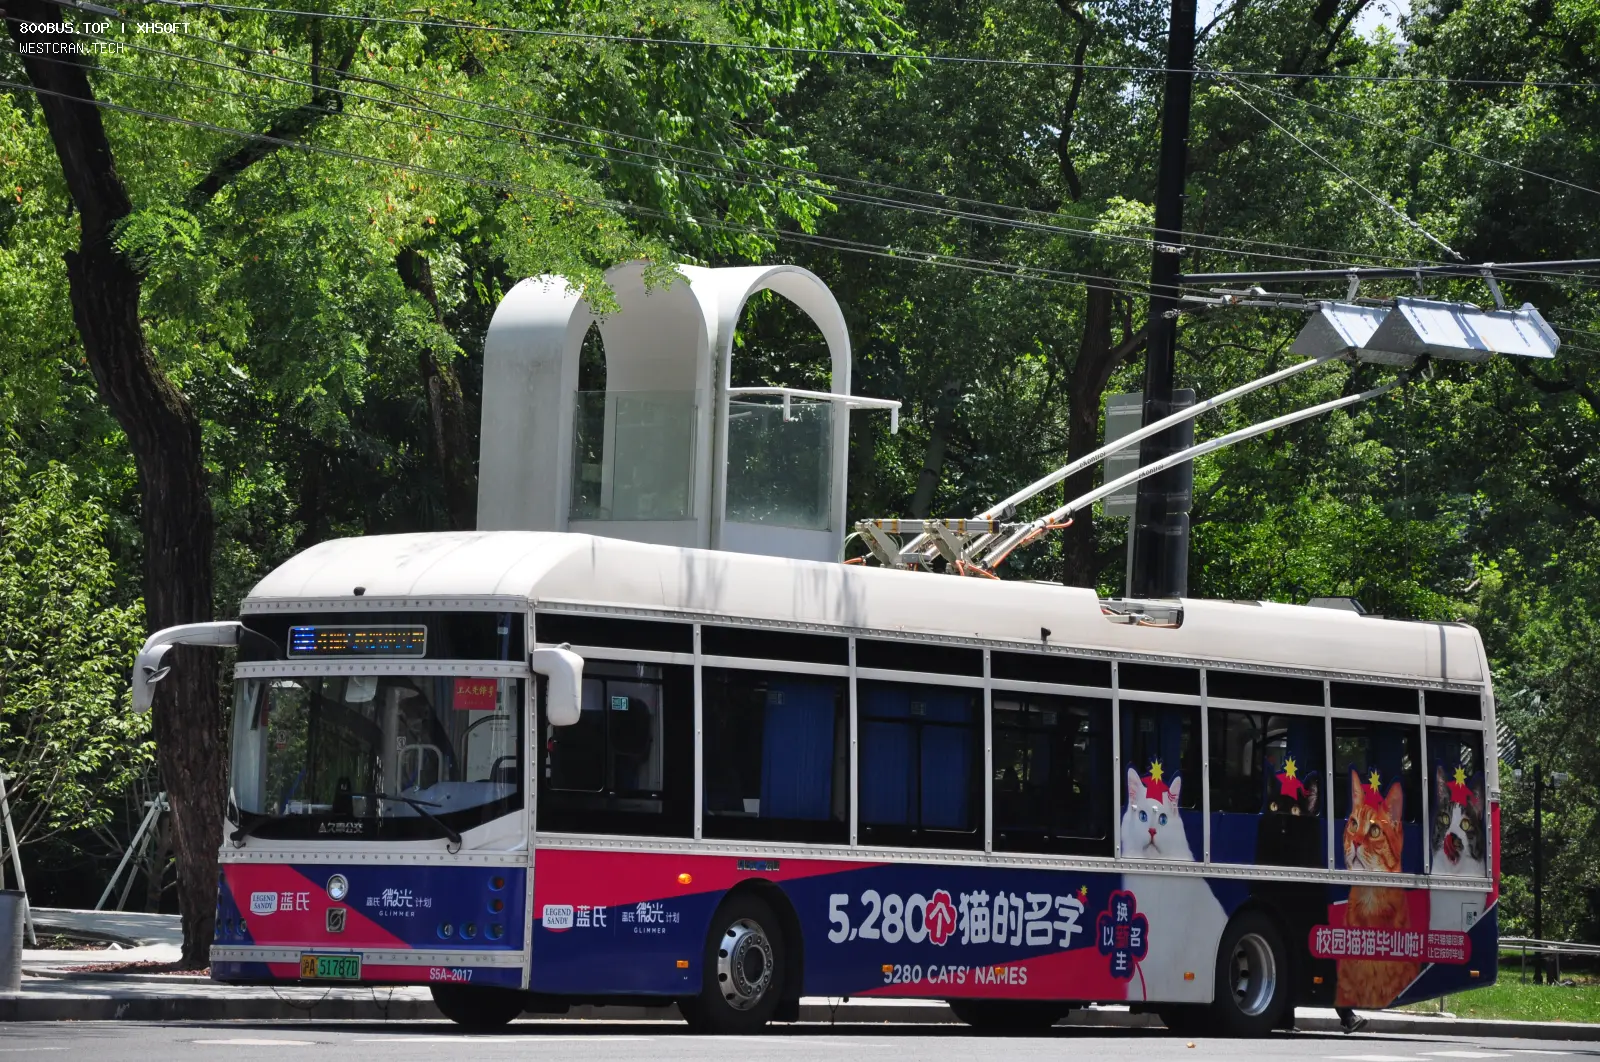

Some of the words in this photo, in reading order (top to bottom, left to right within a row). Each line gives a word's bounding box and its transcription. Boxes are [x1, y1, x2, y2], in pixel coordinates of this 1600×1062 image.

[280, 891, 310, 911] 蓝氏
[545, 908, 572, 916] LEGEND
[547, 916, 569, 924] SANDY
[576, 904, 607, 927] 蓝氏
[429, 967, 473, 982] S5A-2017
[927, 964, 969, 985] CATS'
[975, 966, 1028, 986] NAMES
